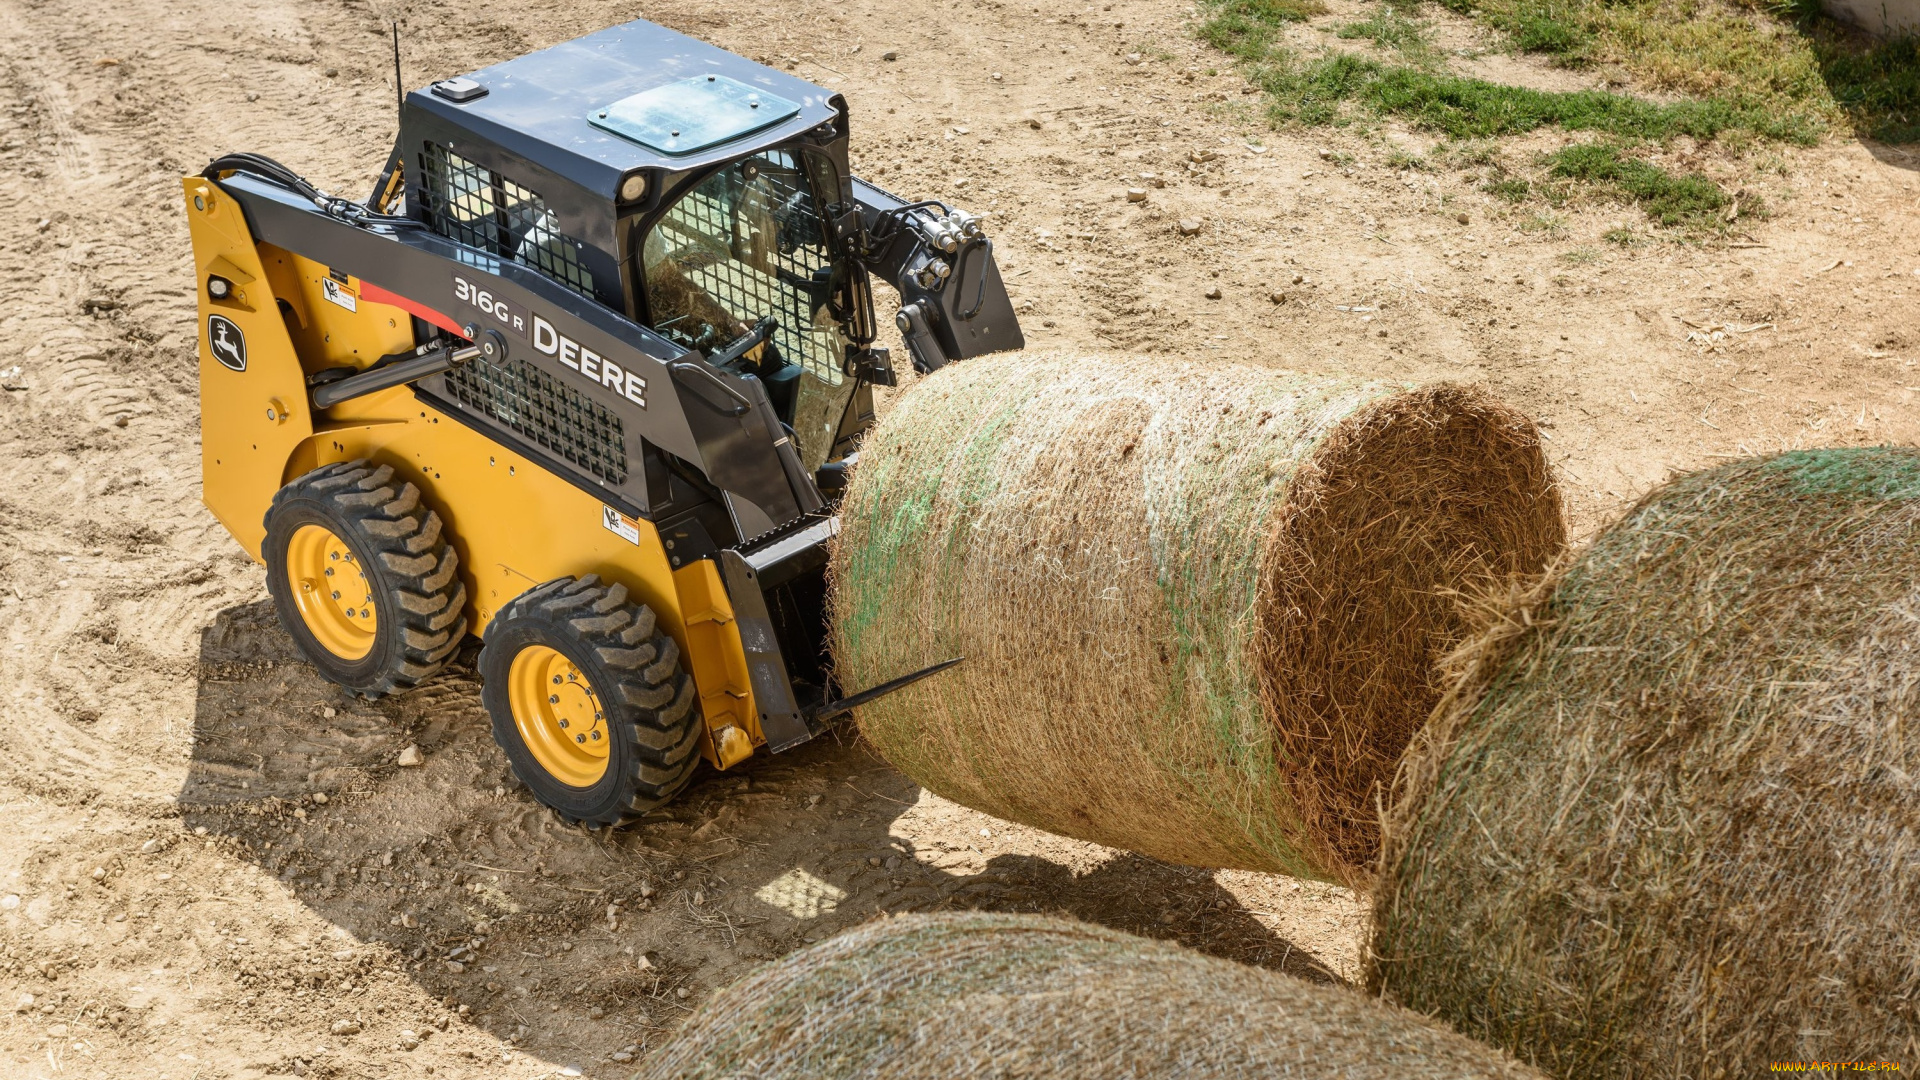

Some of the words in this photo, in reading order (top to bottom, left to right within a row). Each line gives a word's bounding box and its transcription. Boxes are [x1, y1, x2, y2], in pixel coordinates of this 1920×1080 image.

[454, 276, 509, 323] 316G
[513, 314, 524, 332] R
[533, 315, 646, 407] DEERE
